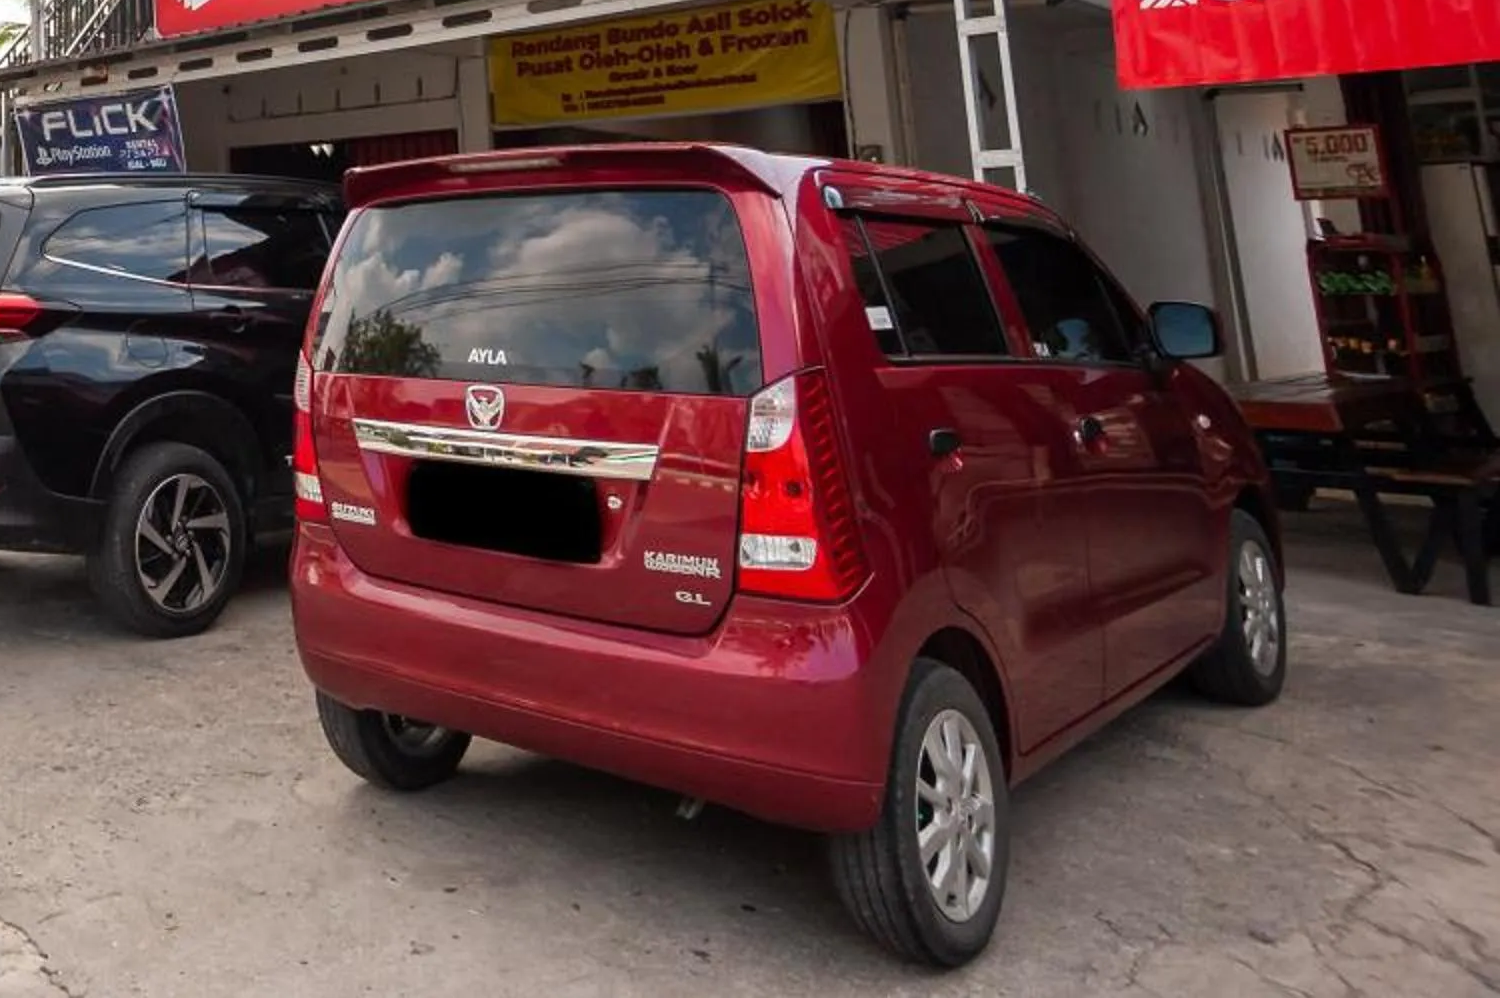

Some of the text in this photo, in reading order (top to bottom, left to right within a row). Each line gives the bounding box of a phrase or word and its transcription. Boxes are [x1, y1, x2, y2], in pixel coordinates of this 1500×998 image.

[510, 0, 813, 59] Rendang Bundo Asli Solok
[516, 57, 574, 78] Pusat
[579, 37, 691, 71] Oleh-Oleh
[697, 37, 714, 57] &
[467, 347, 507, 365] AYLA
[644, 550, 719, 569] KARIMUN
